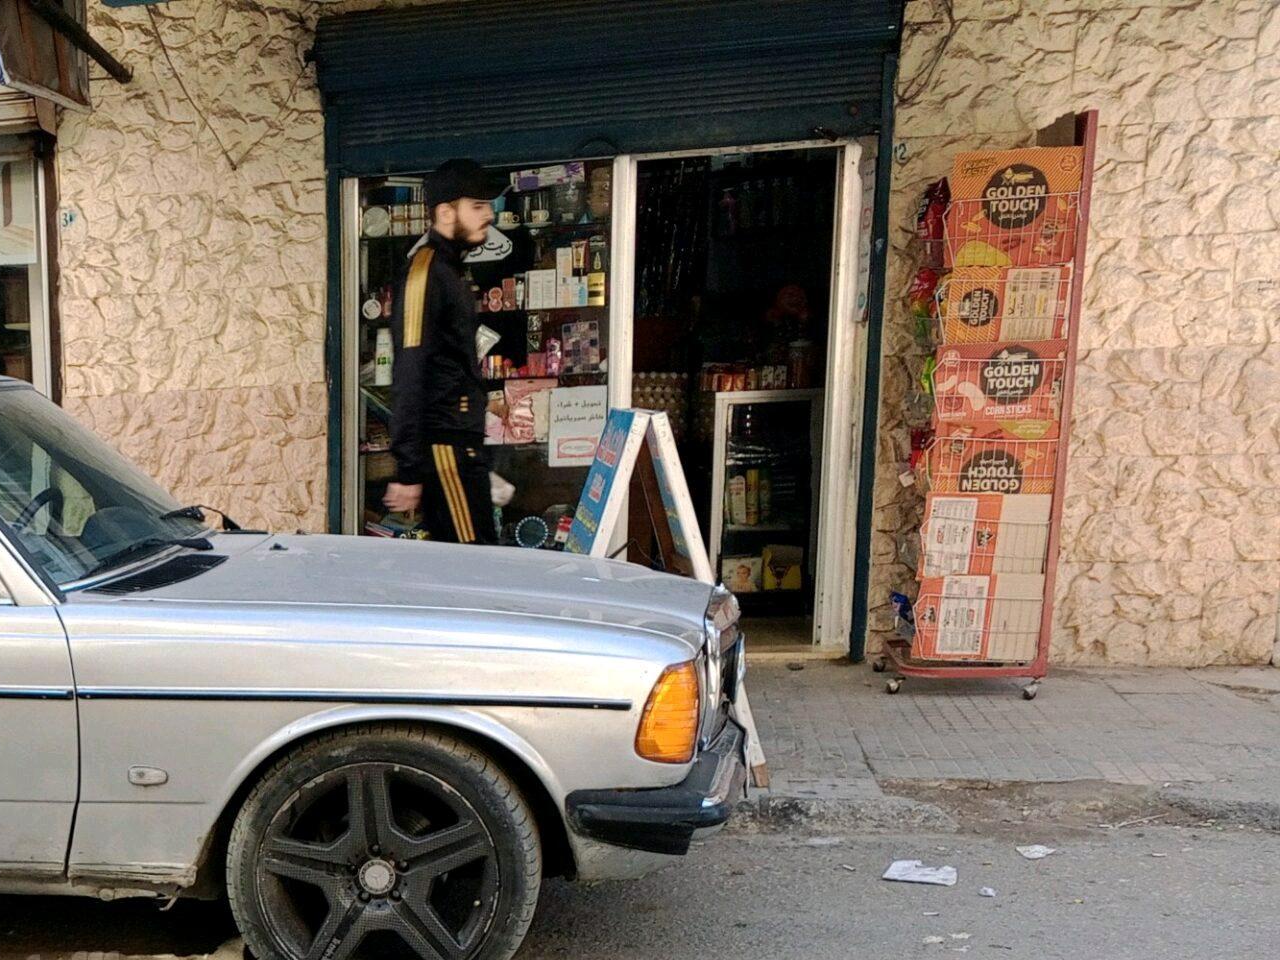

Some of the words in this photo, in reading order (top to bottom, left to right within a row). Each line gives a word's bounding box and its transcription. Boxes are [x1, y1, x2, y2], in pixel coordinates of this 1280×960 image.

[986, 185, 1046, 199] GOLDEN
[991, 199, 1039, 212] TOUCH
[984, 364, 1039, 377] GOLDEN
[988, 377, 1034, 389] TOUCH
